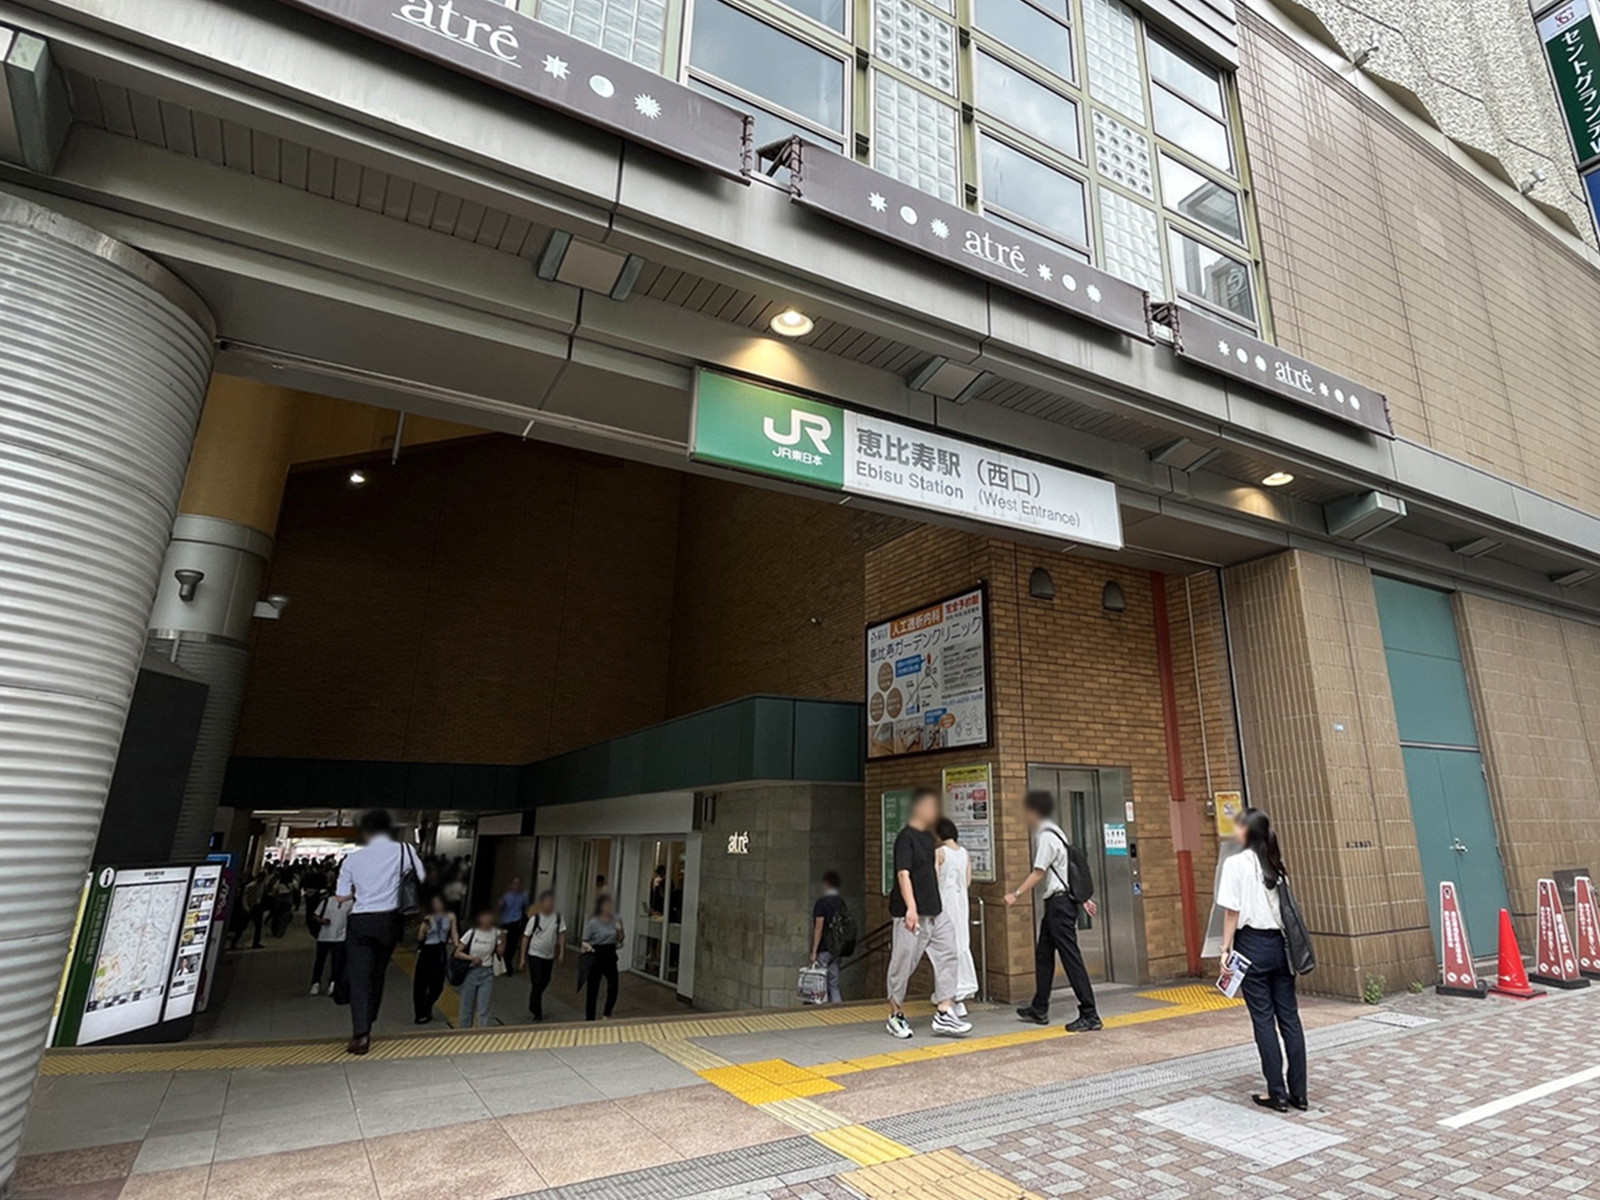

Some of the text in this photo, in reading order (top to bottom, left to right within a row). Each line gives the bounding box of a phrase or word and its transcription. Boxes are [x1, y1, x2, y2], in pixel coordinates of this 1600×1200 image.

[399, 0, 520, 62] atré
[964, 230, 1026, 275] atré
[1274, 361, 1314, 394] atré
[763, 408, 832, 456] JR
[772, 446, 824, 466] JR東日本
[856, 427, 1042, 499] 恵比寿駅 （西口）
[856, 461, 1081, 528] Ebisu Station (West Entrance)
[869, 615, 983, 664] 恵比寿ガーデンクリニック
[727, 831, 749, 854] atré
